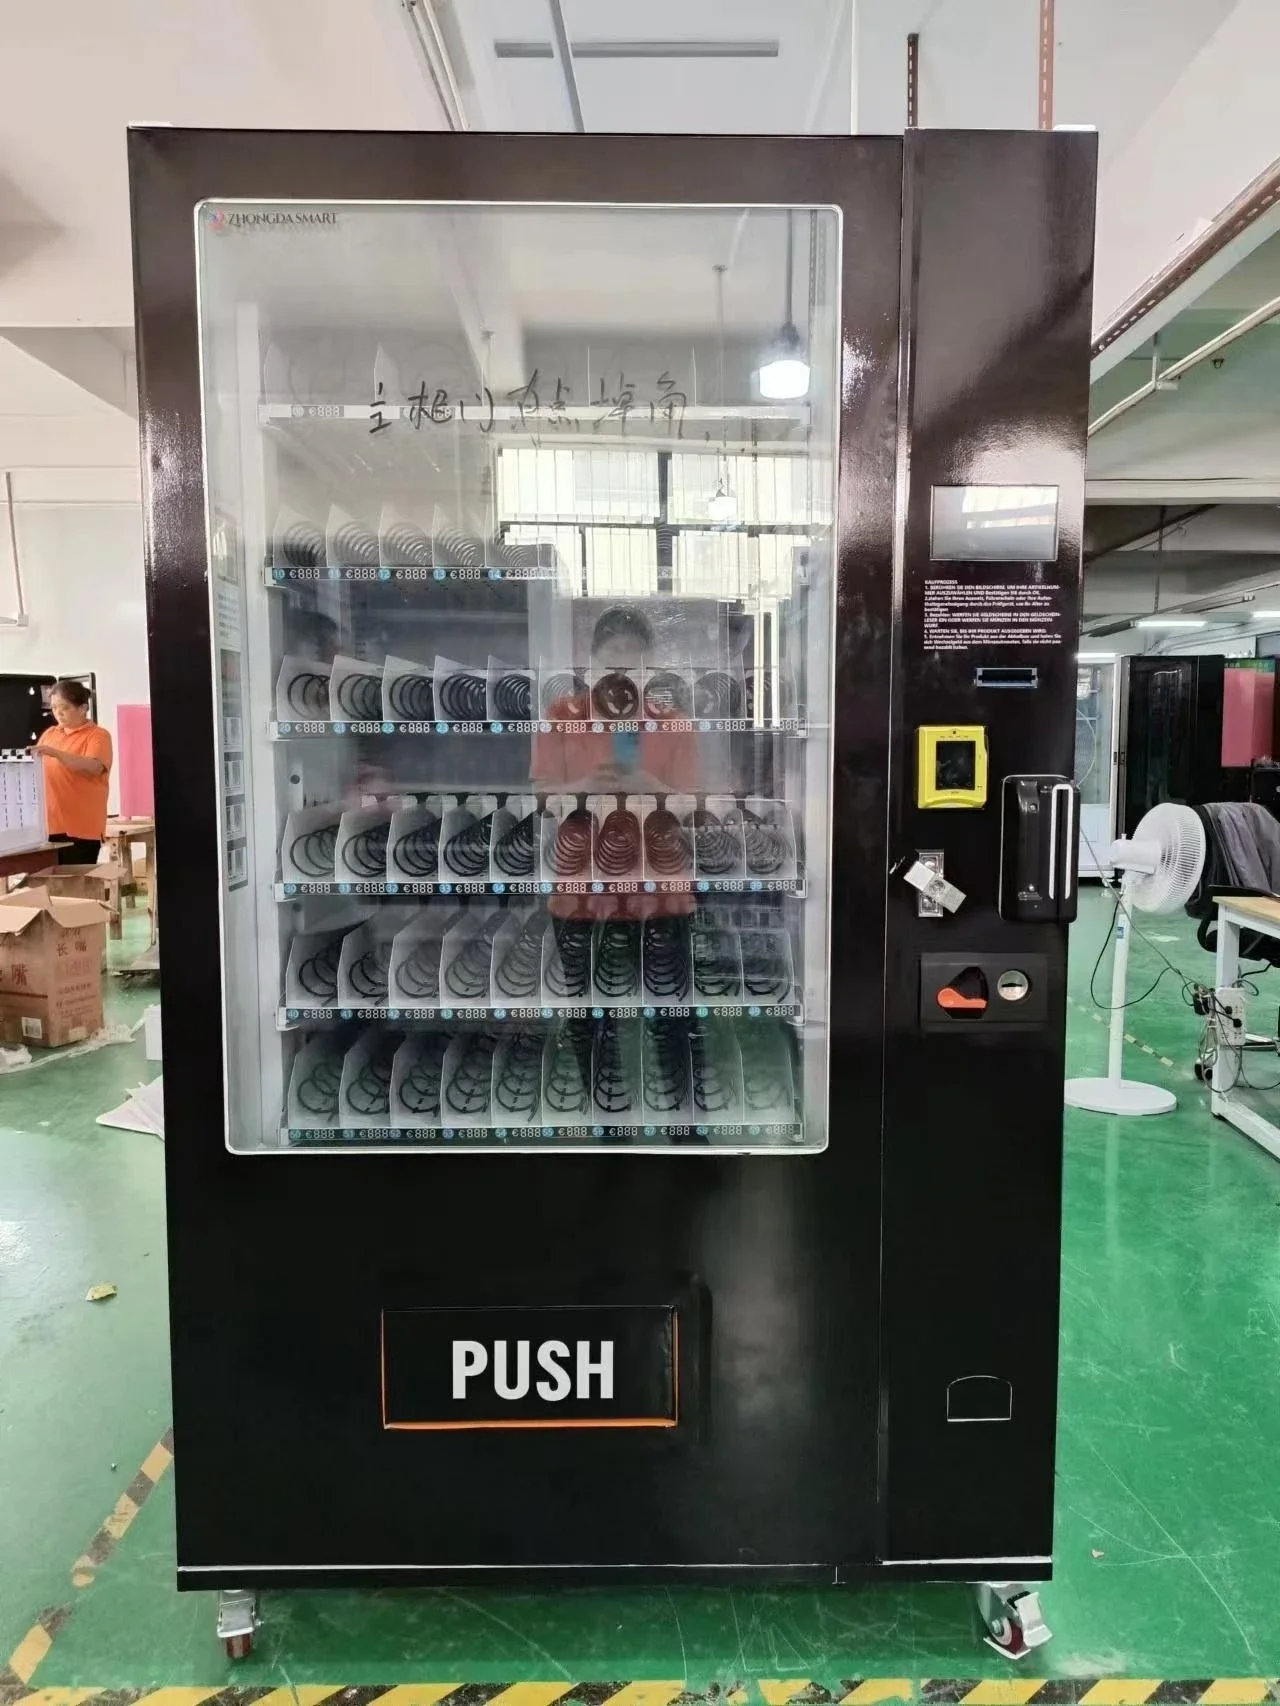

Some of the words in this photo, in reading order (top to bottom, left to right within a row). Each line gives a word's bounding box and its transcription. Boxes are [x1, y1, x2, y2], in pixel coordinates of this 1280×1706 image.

[226, 212, 293, 227] ZHONGDA
[296, 212, 338, 225] SMART
[452, 1340, 614, 1402] PUSH
